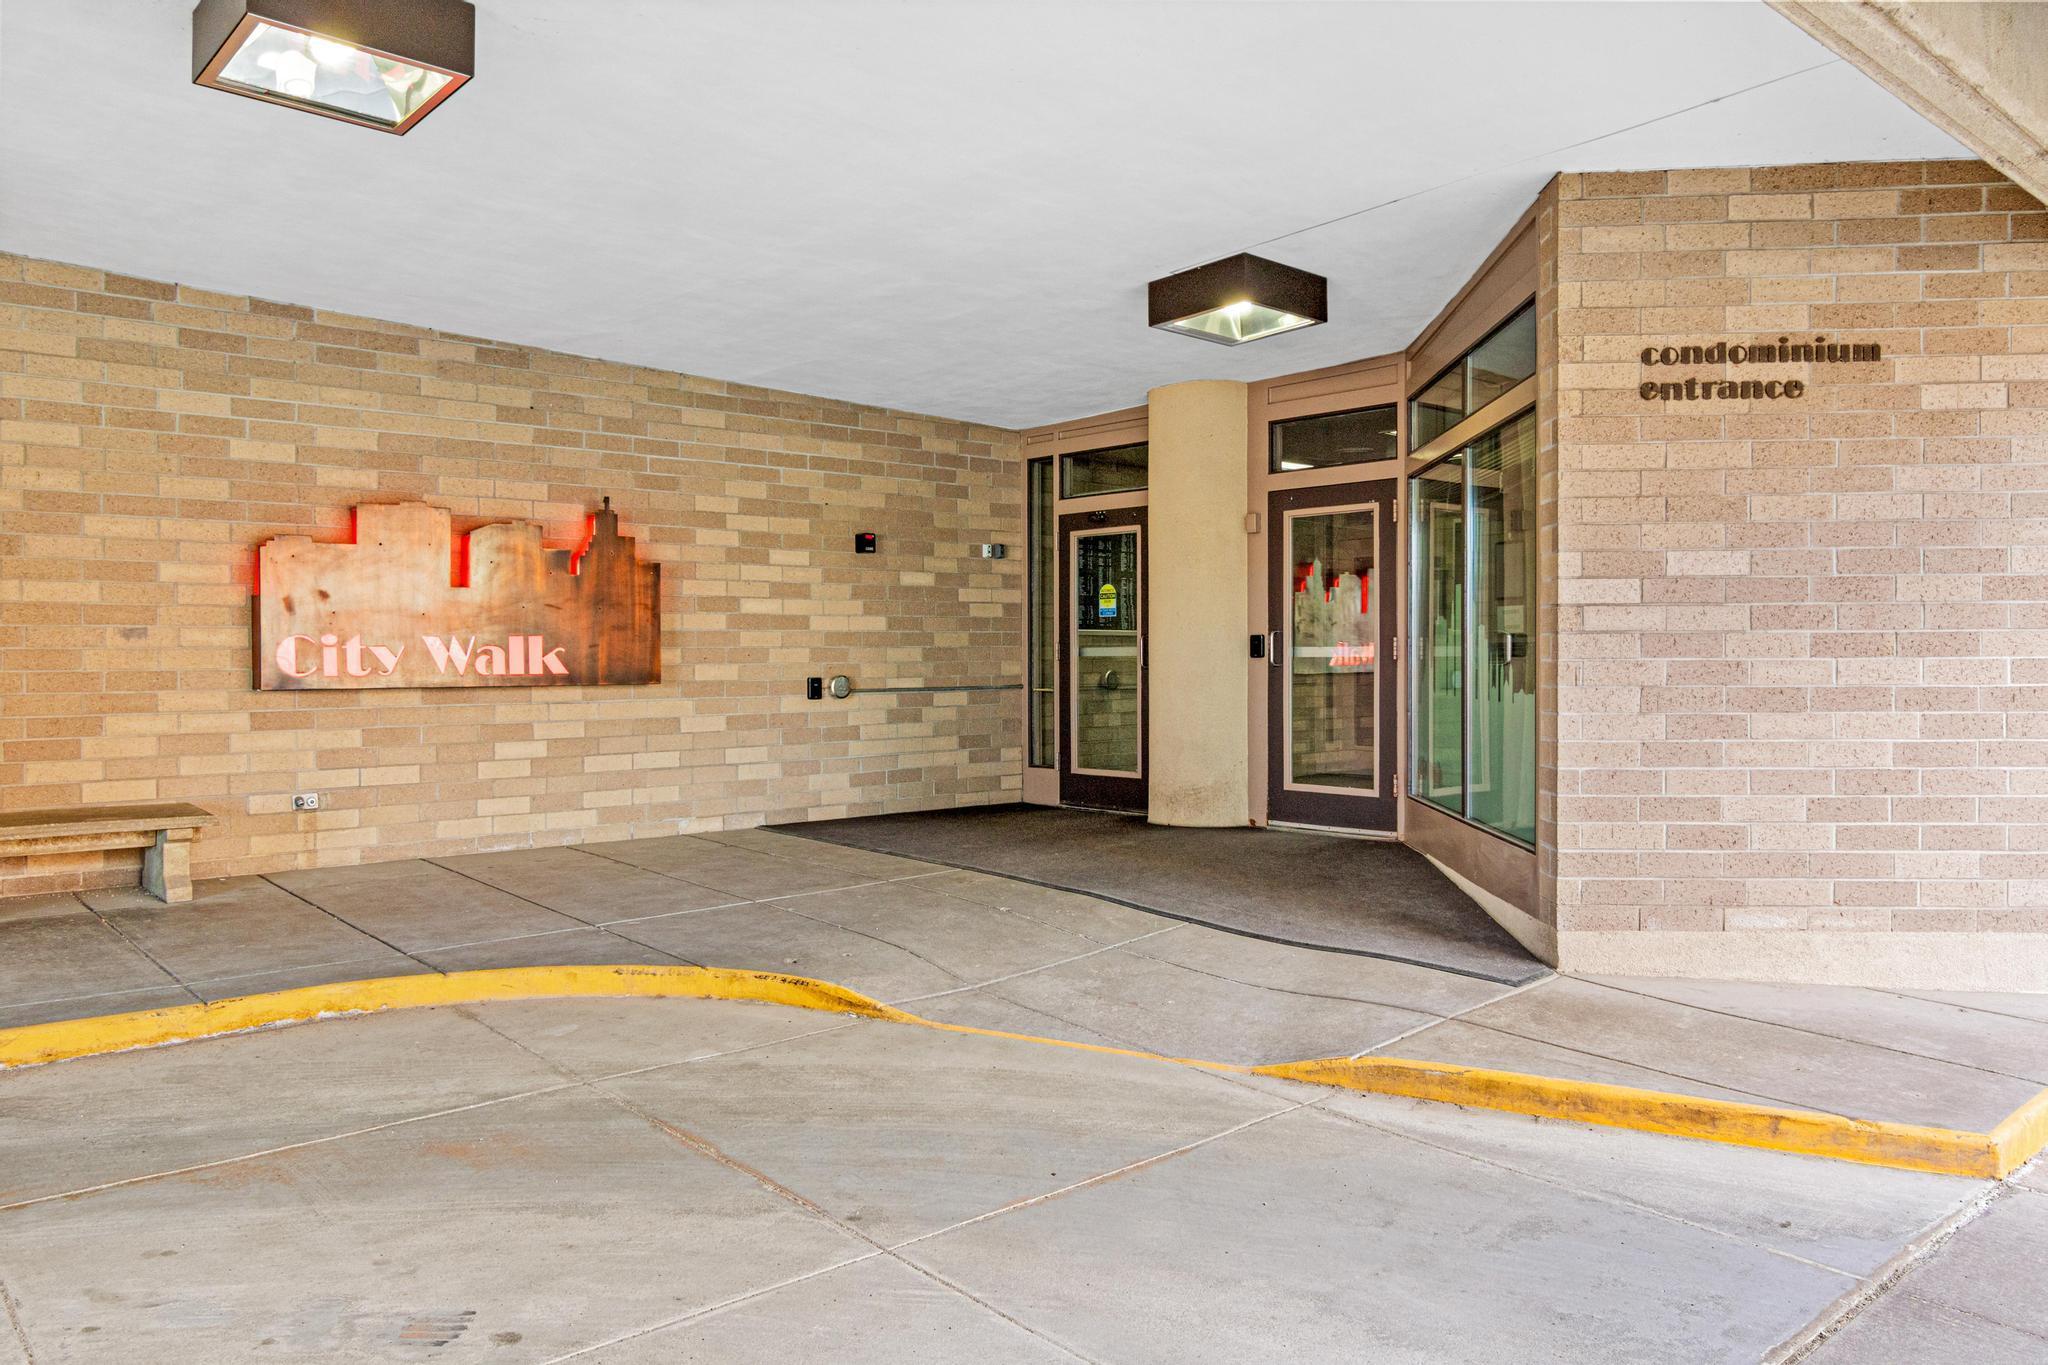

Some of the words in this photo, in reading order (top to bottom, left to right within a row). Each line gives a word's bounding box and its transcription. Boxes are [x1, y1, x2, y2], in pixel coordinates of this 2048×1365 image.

[1640, 336, 1881, 366] condominium
[1640, 377, 1804, 400] entrance
[276, 633, 405, 678] City
[422, 634, 569, 676] Walk
